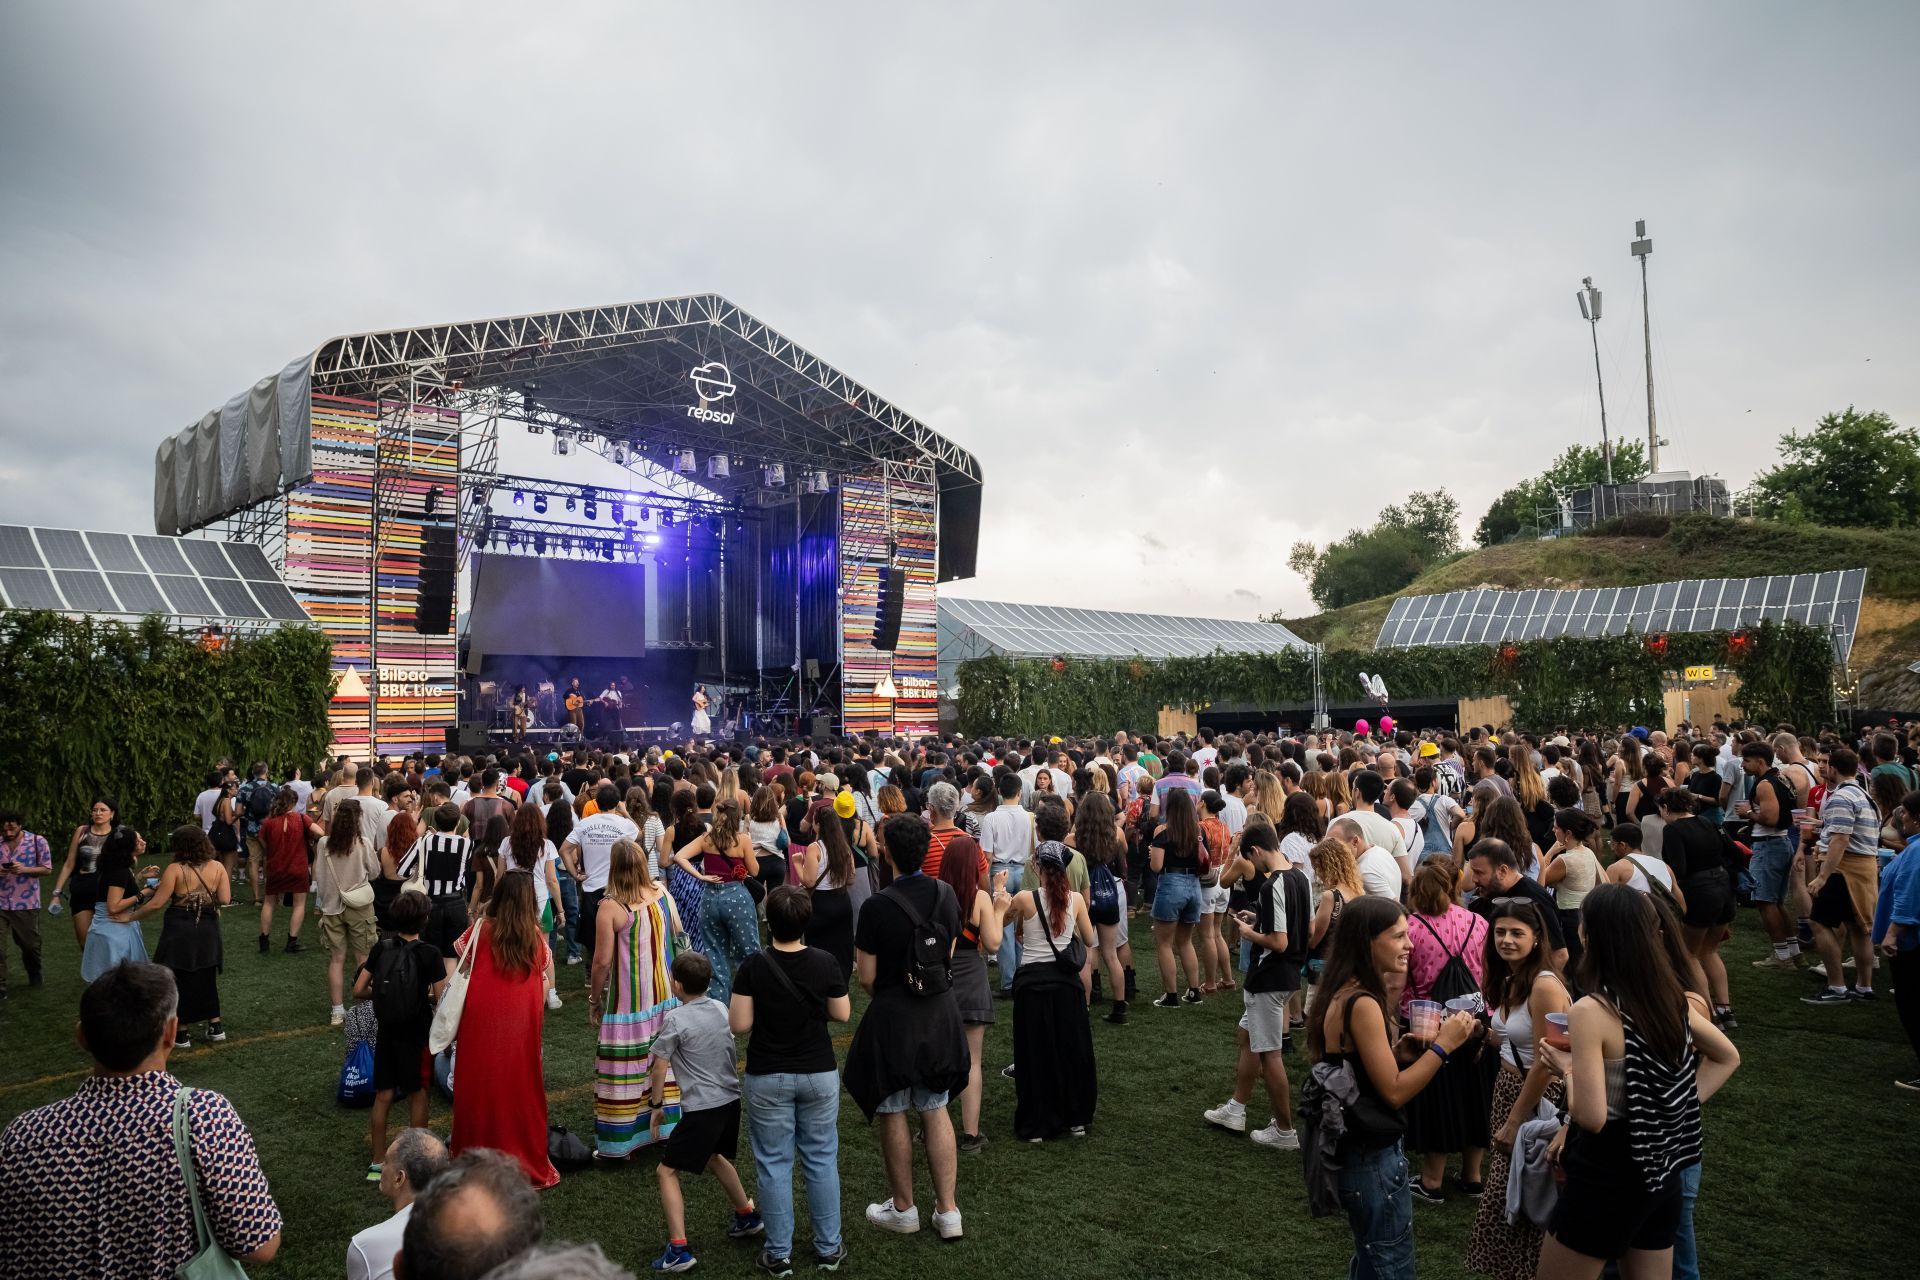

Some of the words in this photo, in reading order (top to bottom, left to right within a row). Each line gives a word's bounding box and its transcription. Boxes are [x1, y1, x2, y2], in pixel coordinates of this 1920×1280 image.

[687, 406, 735, 425] repsol
[379, 668, 429, 682] Bilbao
[1687, 669, 1710, 678] WC
[903, 676, 930, 687] Bilbao
[379, 683, 409, 697] BBK
[414, 683, 443, 697] Live
[903, 688, 920, 699] BBK
[921, 688, 938, 699] Live
